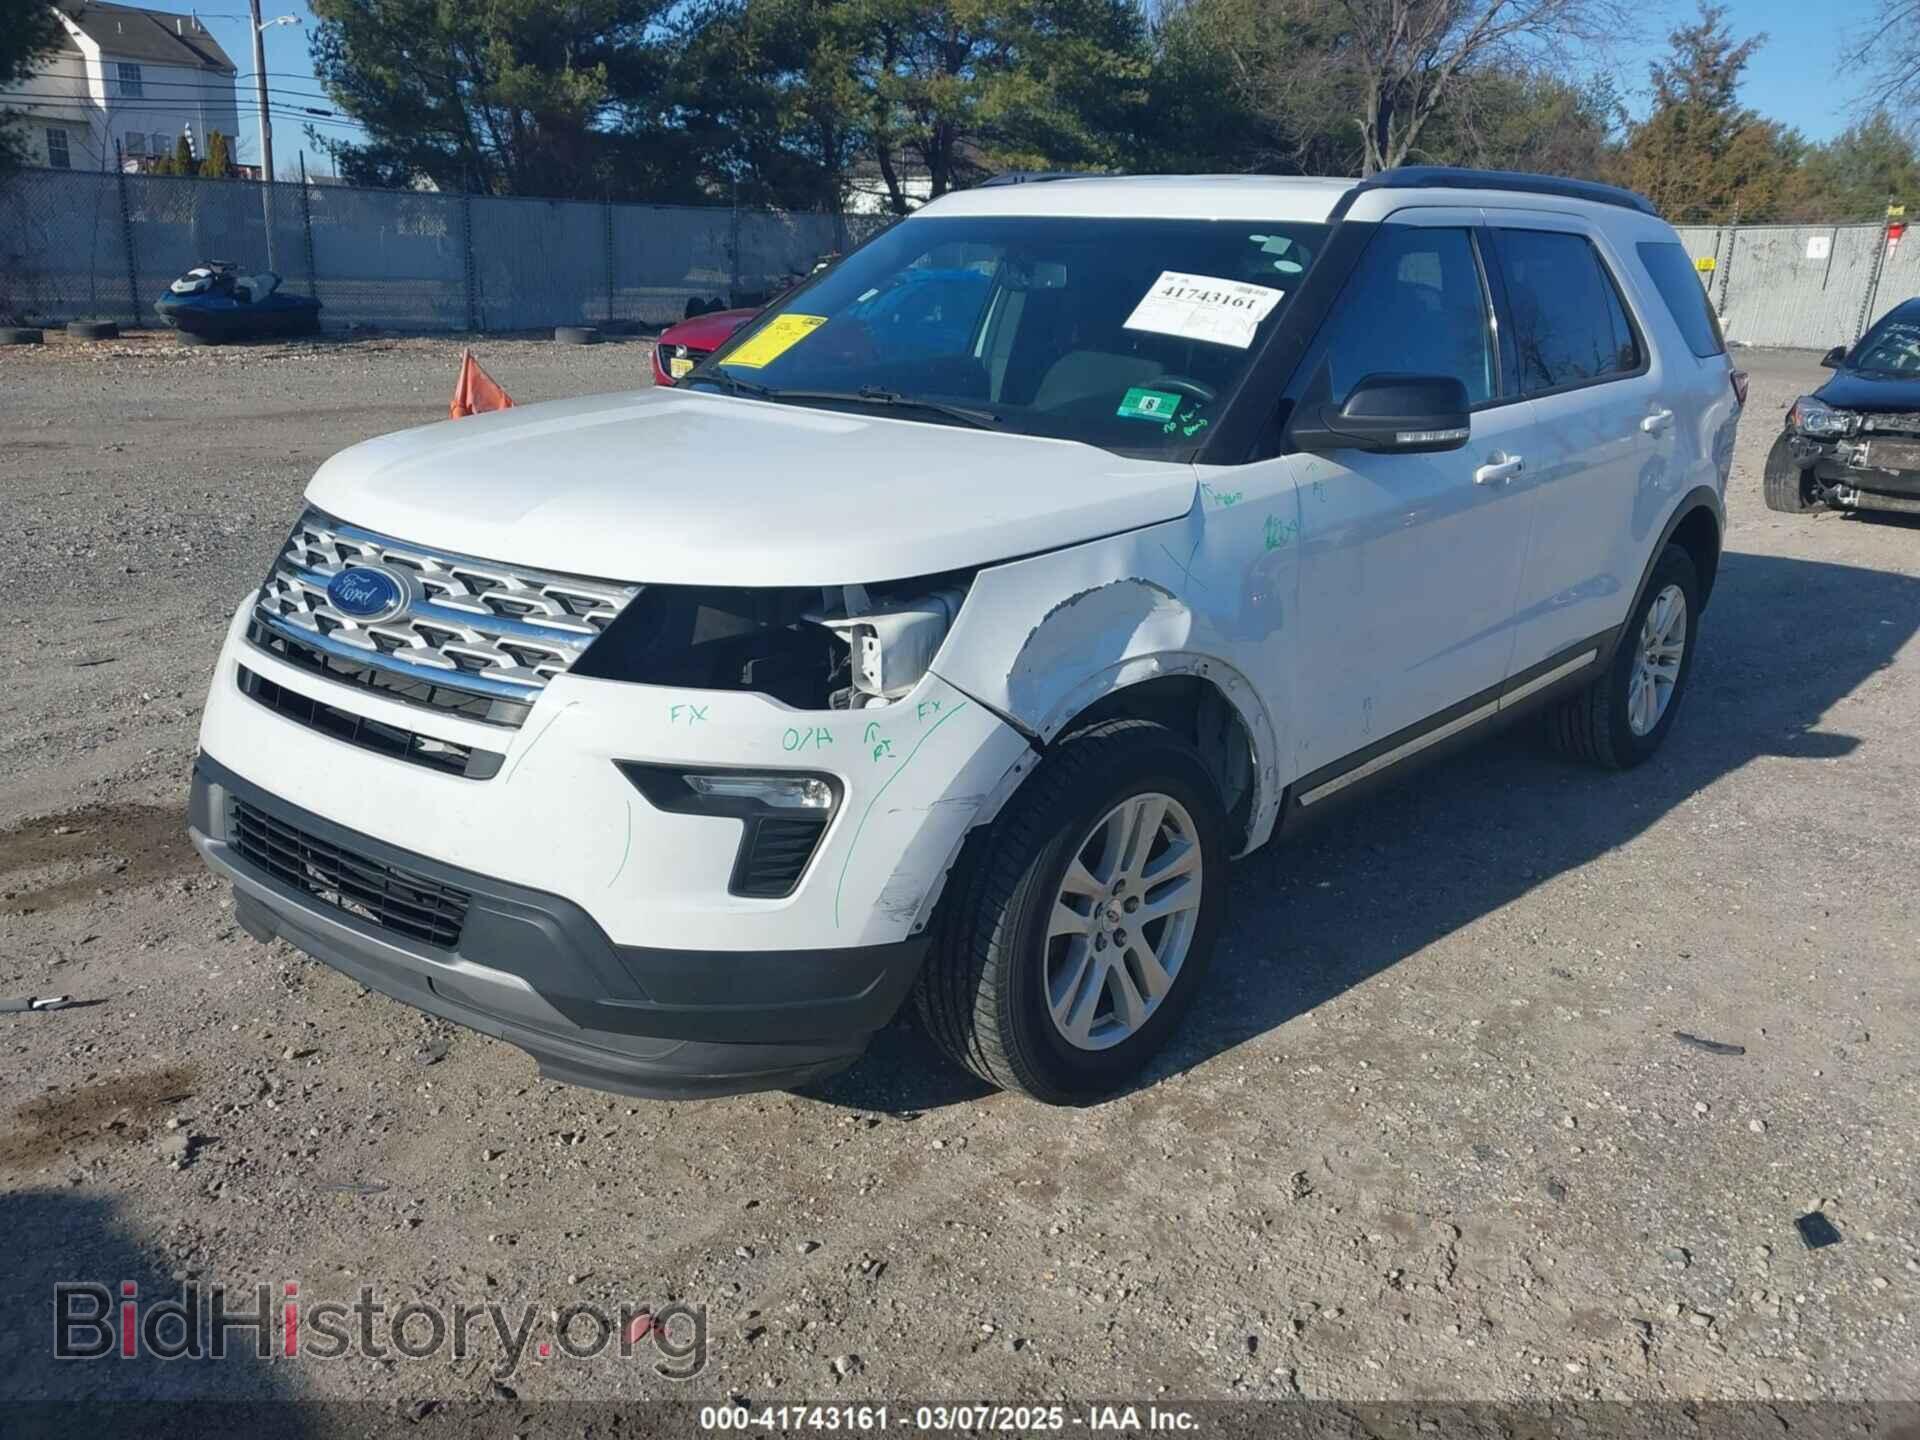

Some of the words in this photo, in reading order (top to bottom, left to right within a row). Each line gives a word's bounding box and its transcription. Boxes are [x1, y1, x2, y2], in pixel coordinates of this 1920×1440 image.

[1161, 286, 1256, 310] 41743161
[335, 573, 378, 608] Ford
[782, 727, 833, 751] O/H
